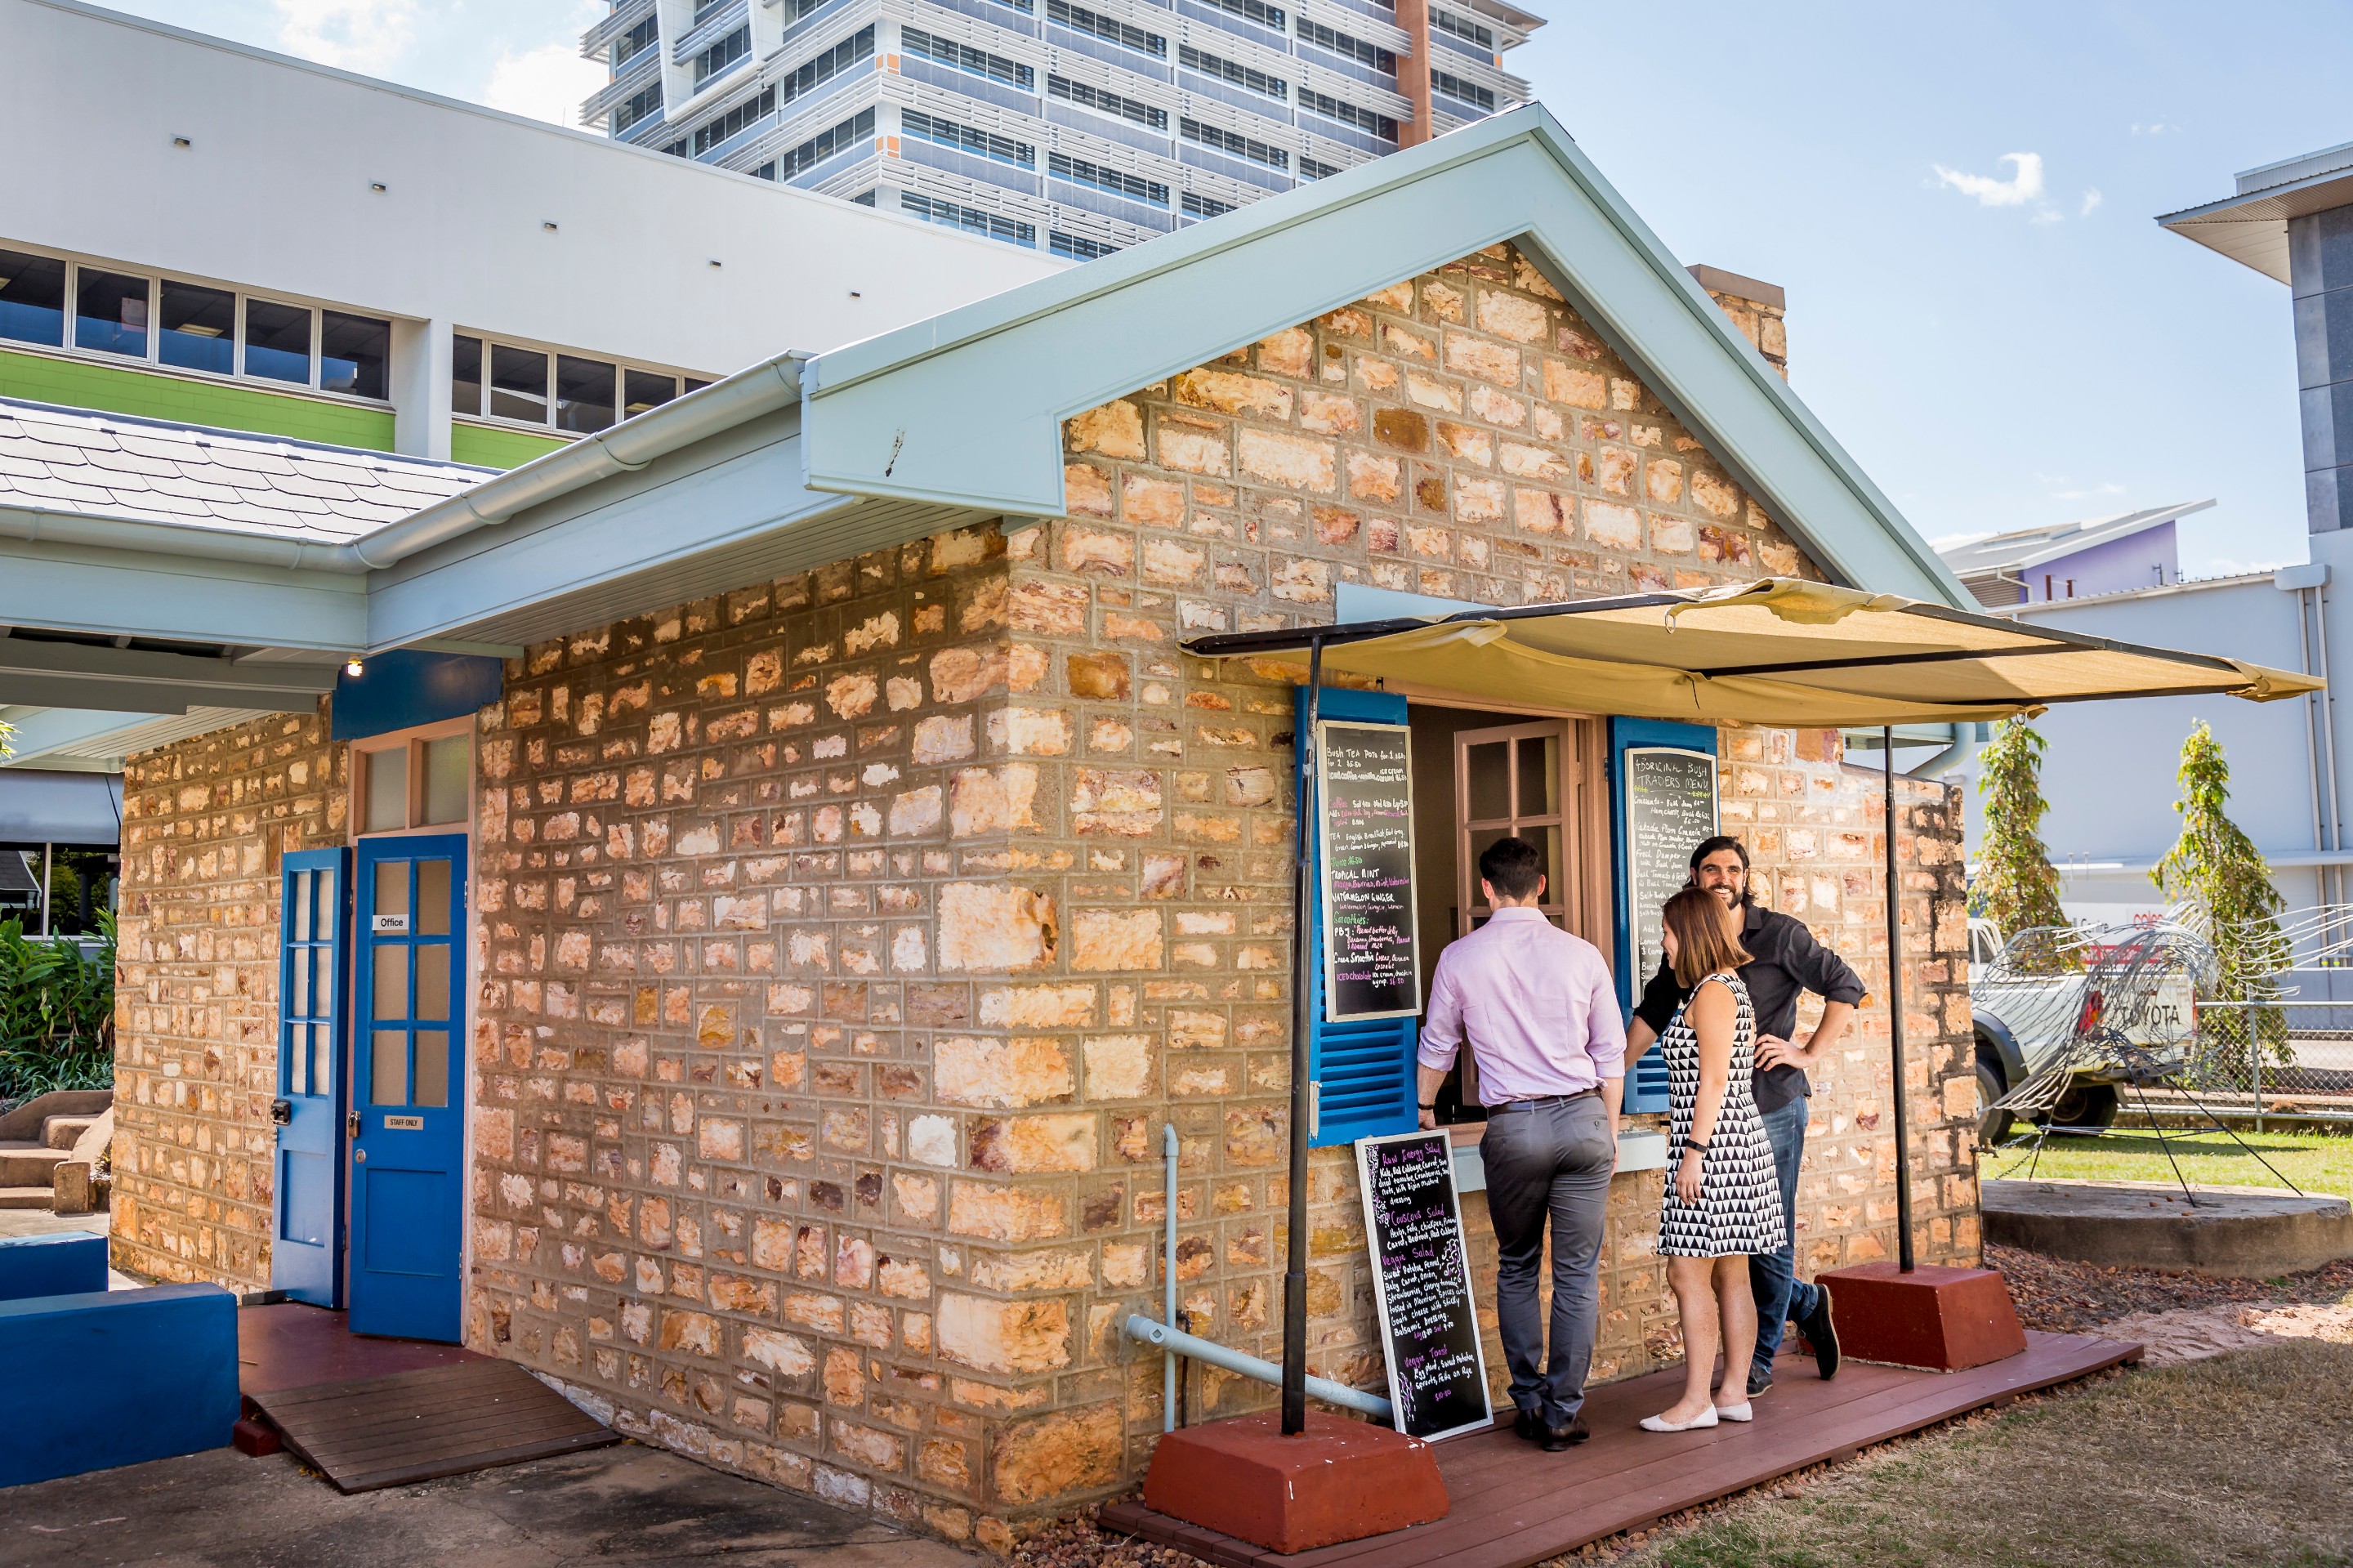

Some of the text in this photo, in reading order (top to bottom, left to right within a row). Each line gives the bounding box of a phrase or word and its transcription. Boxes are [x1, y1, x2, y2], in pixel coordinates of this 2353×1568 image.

[1327, 746, 1344, 758] Bush
[1346, 749, 1360, 758] TEA
[1337, 759, 1342, 767] 2
[1688, 762, 1708, 778] BUSH
[1637, 775, 1708, 791] TRADERS MENU
[1329, 833, 1341, 841] TEA
[1656, 850, 1681, 863] Damper
[1332, 869, 1380, 881] TROPICAL MINT
[1333, 891, 1395, 903] WATERMELON GINGER
[381, 918, 404, 927] Office
[1640, 936, 1659, 945] Lemon
[405, 1119, 418, 1127] ONLY
[1383, 1154, 1398, 1166] Raw
[1402, 1150, 1424, 1162] Energy
[1391, 1196, 1412, 1205] dressing
[1391, 1204, 1444, 1226] Couscous Salad
[1382, 1244, 1435, 1271] Veggie Salad
[1383, 1268, 1401, 1280] Sweet
[1386, 1280, 1400, 1292] Baby
[1407, 1301, 1413, 1310] in
[1456, 1286, 1467, 1295] and
[1431, 1301, 1442, 1311] with
[1394, 1321, 1422, 1337] Balsamic
[1405, 1344, 1448, 1369] Veggie Toast
[1462, 1366, 1473, 1379] Rye
